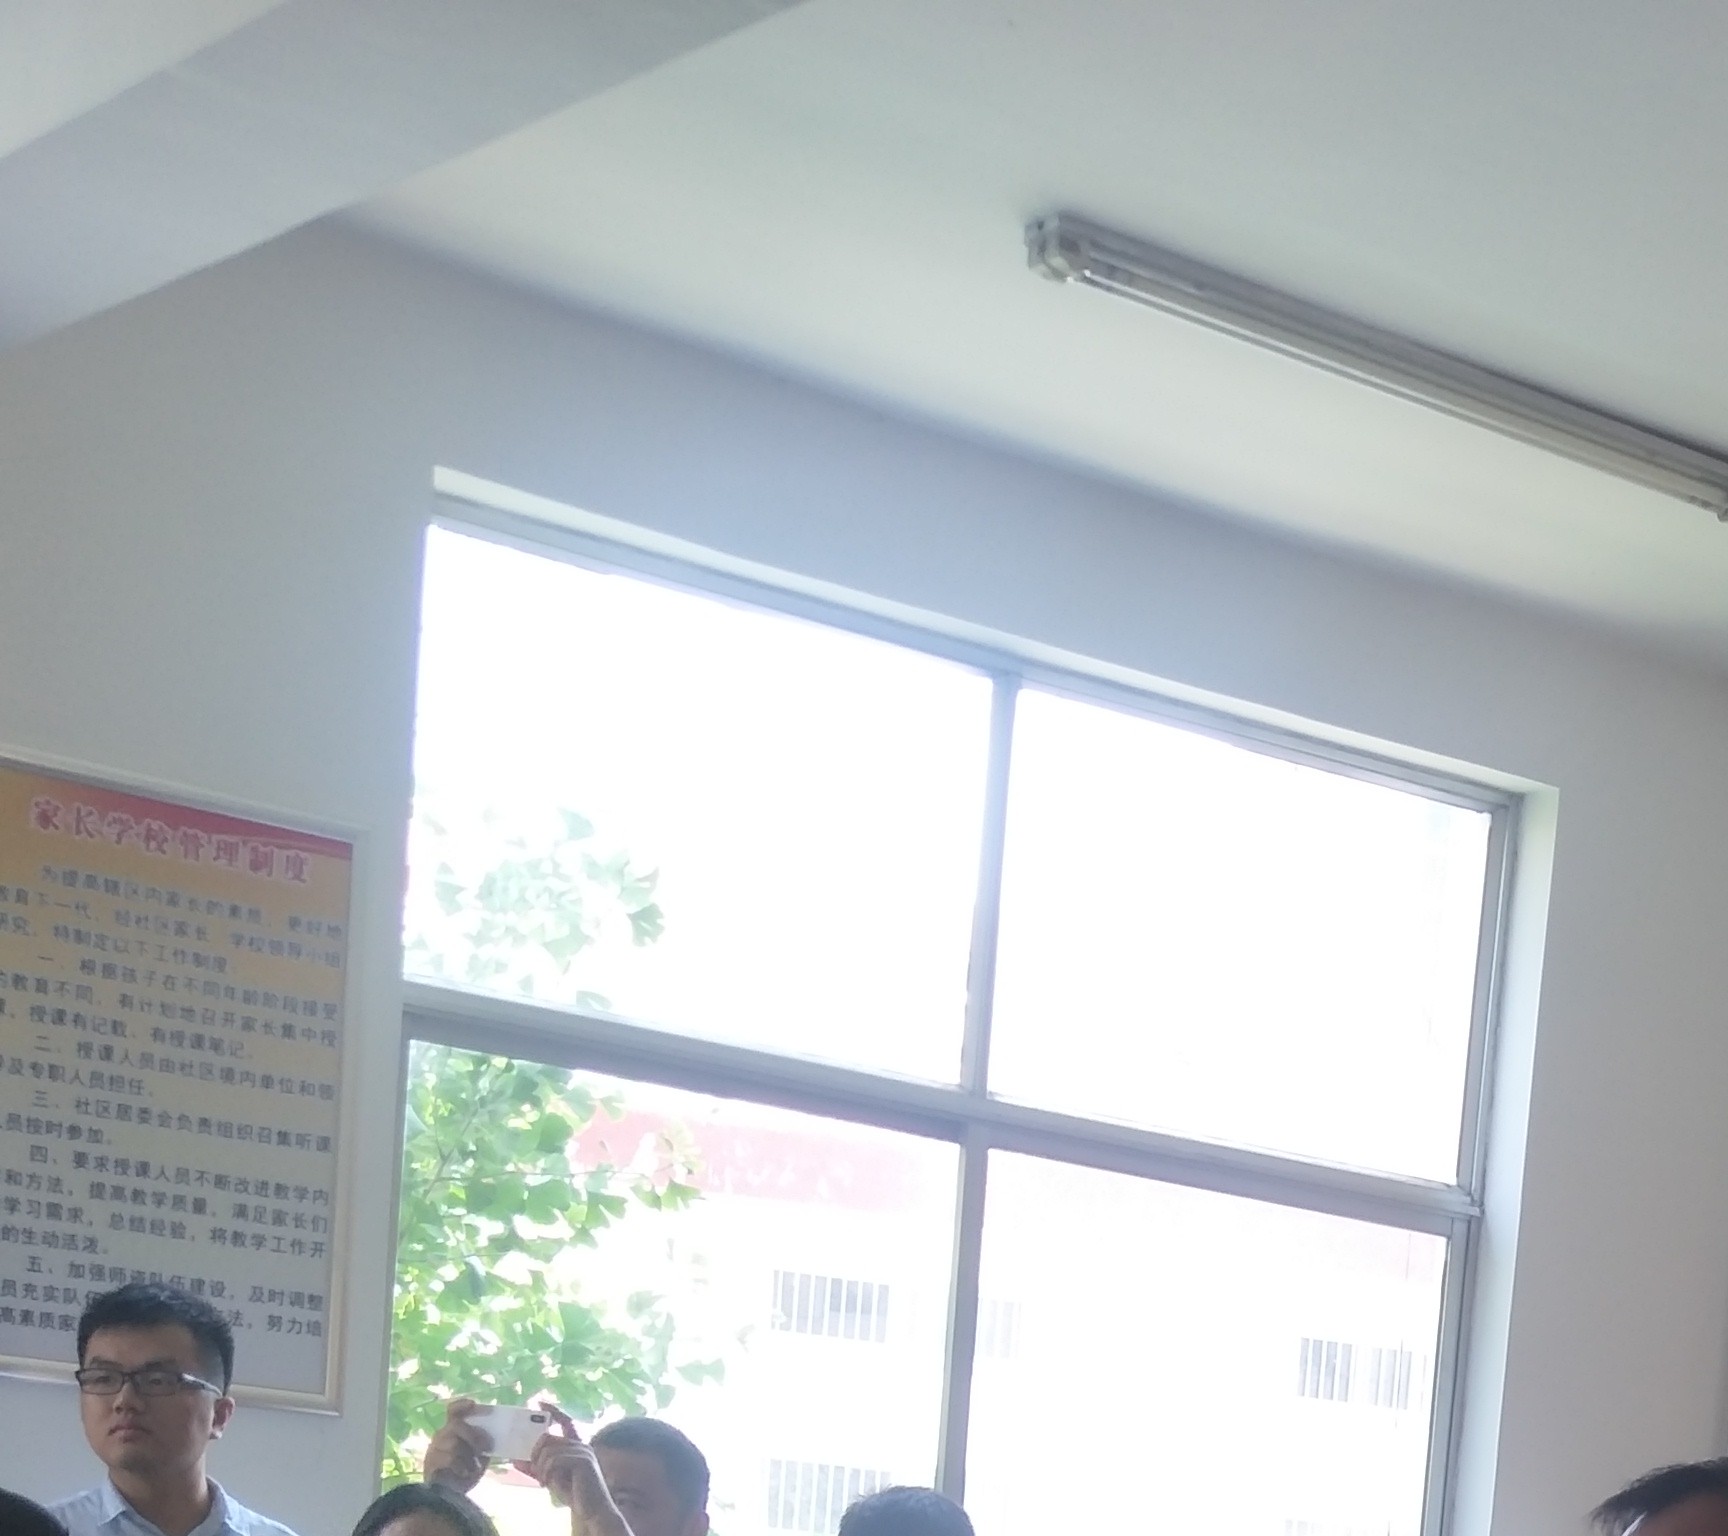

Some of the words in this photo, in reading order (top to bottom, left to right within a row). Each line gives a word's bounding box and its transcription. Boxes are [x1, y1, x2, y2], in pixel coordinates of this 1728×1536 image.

[34, 800, 309, 883] 家长学校管理制度
[0, 1112, 112, 1146] 员按时参加。
